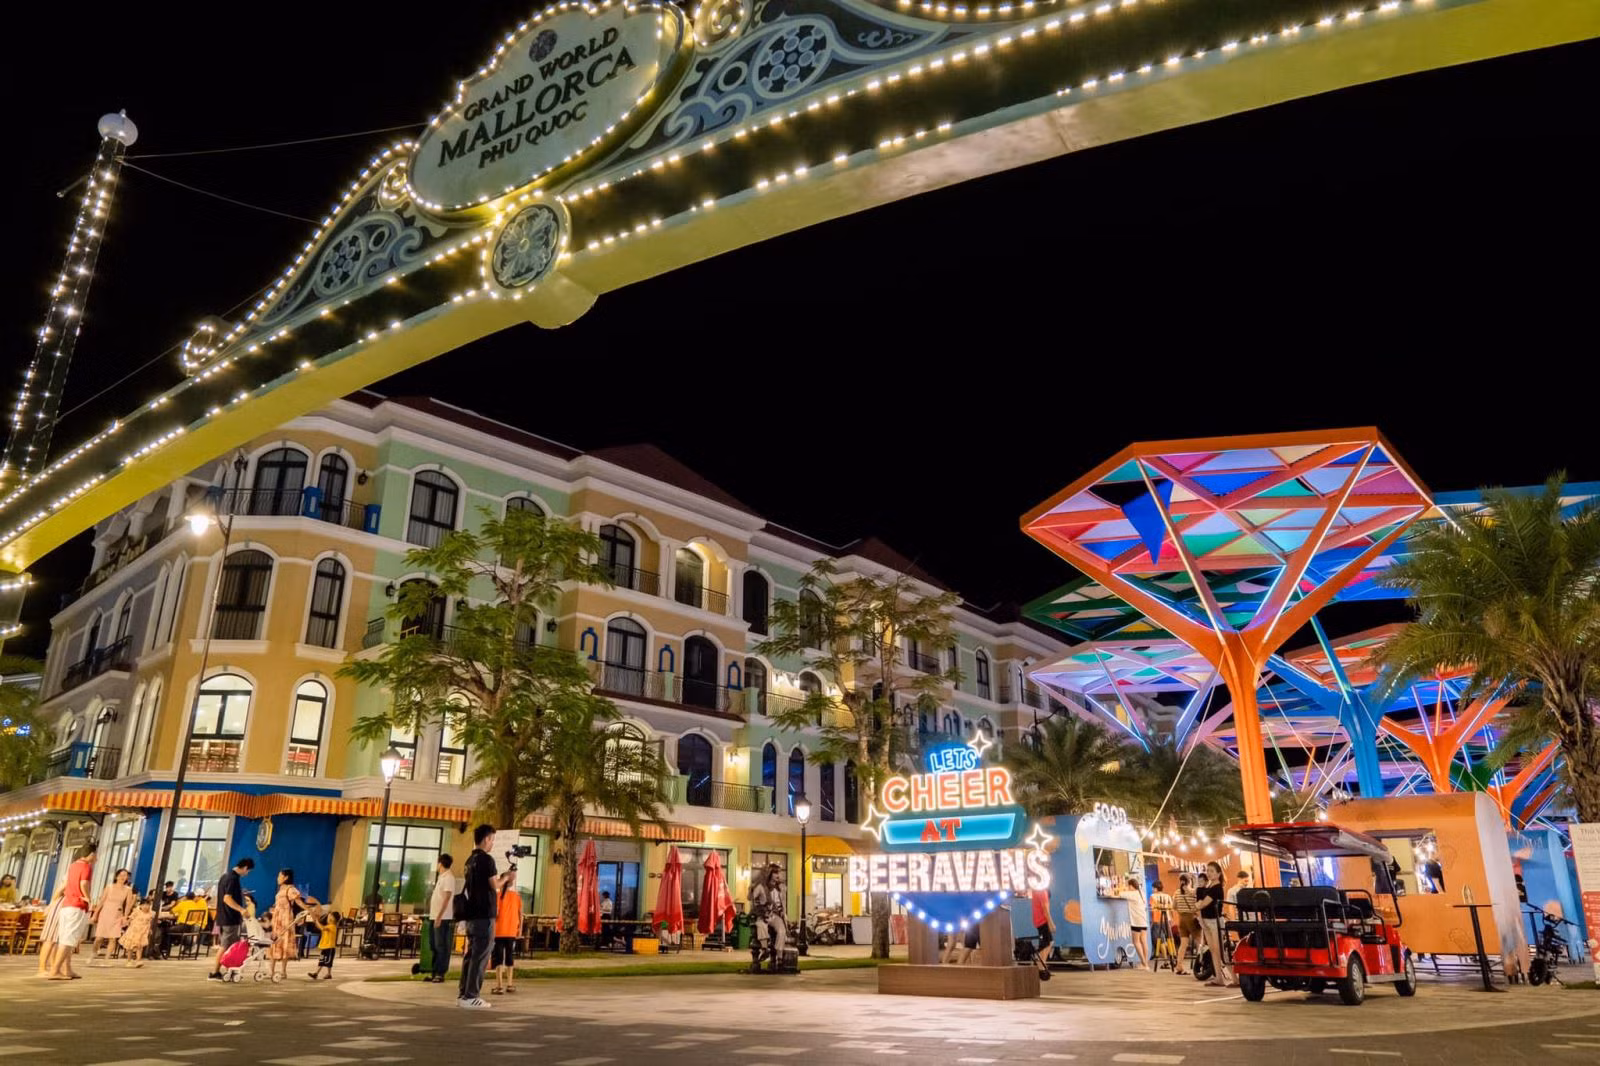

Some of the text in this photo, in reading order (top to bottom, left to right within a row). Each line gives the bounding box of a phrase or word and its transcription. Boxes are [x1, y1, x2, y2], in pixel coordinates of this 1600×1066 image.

[465, 28, 618, 121] GRAND WORLD
[438, 46, 636, 168] MALLORCA
[479, 101, 588, 167] PHU QUOC
[930, 749, 977, 773] LETS
[883, 768, 1014, 811] CHEER
[921, 819, 961, 842] AT
[849, 848, 1051, 892] BEERAVANS
